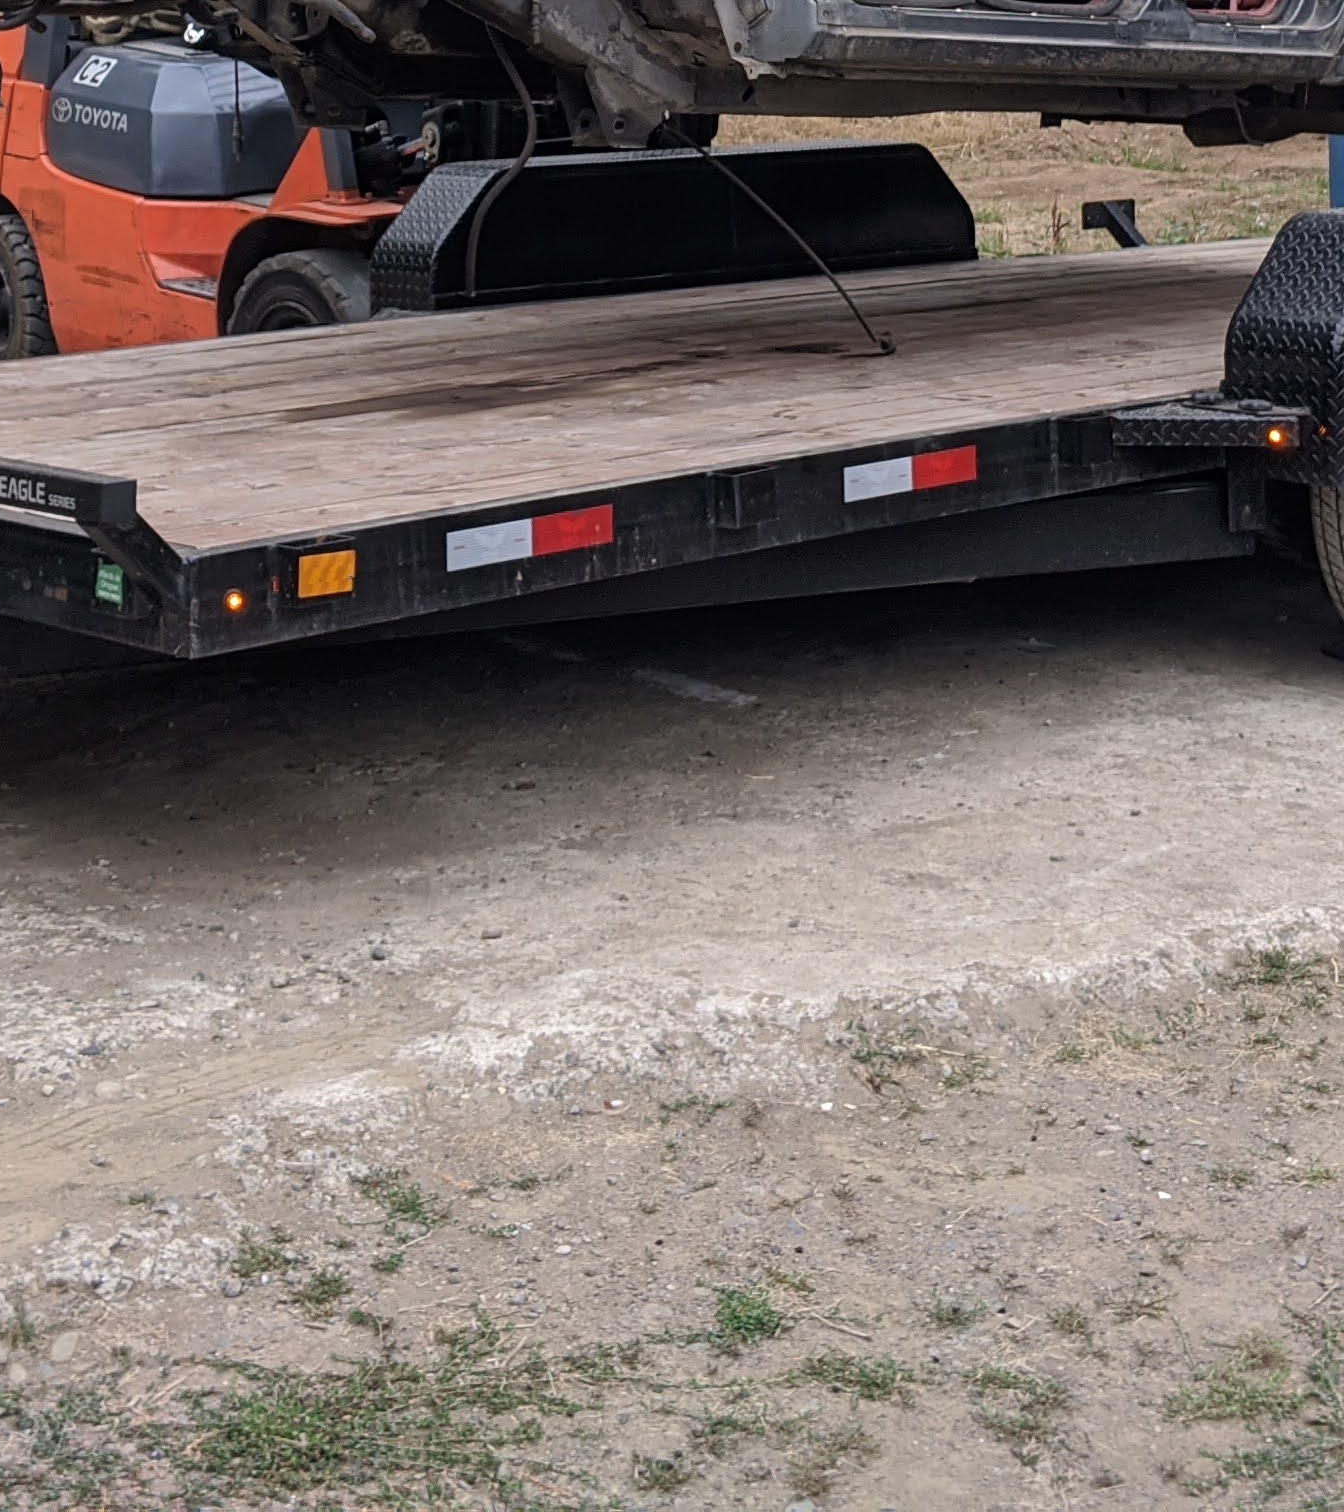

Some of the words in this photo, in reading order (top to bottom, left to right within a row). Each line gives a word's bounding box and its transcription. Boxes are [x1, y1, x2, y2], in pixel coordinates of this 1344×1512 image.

[78, 57, 112, 84] C2
[74, 103, 128, 133] TOYOTA
[48, 493, 76, 511] SERIES
